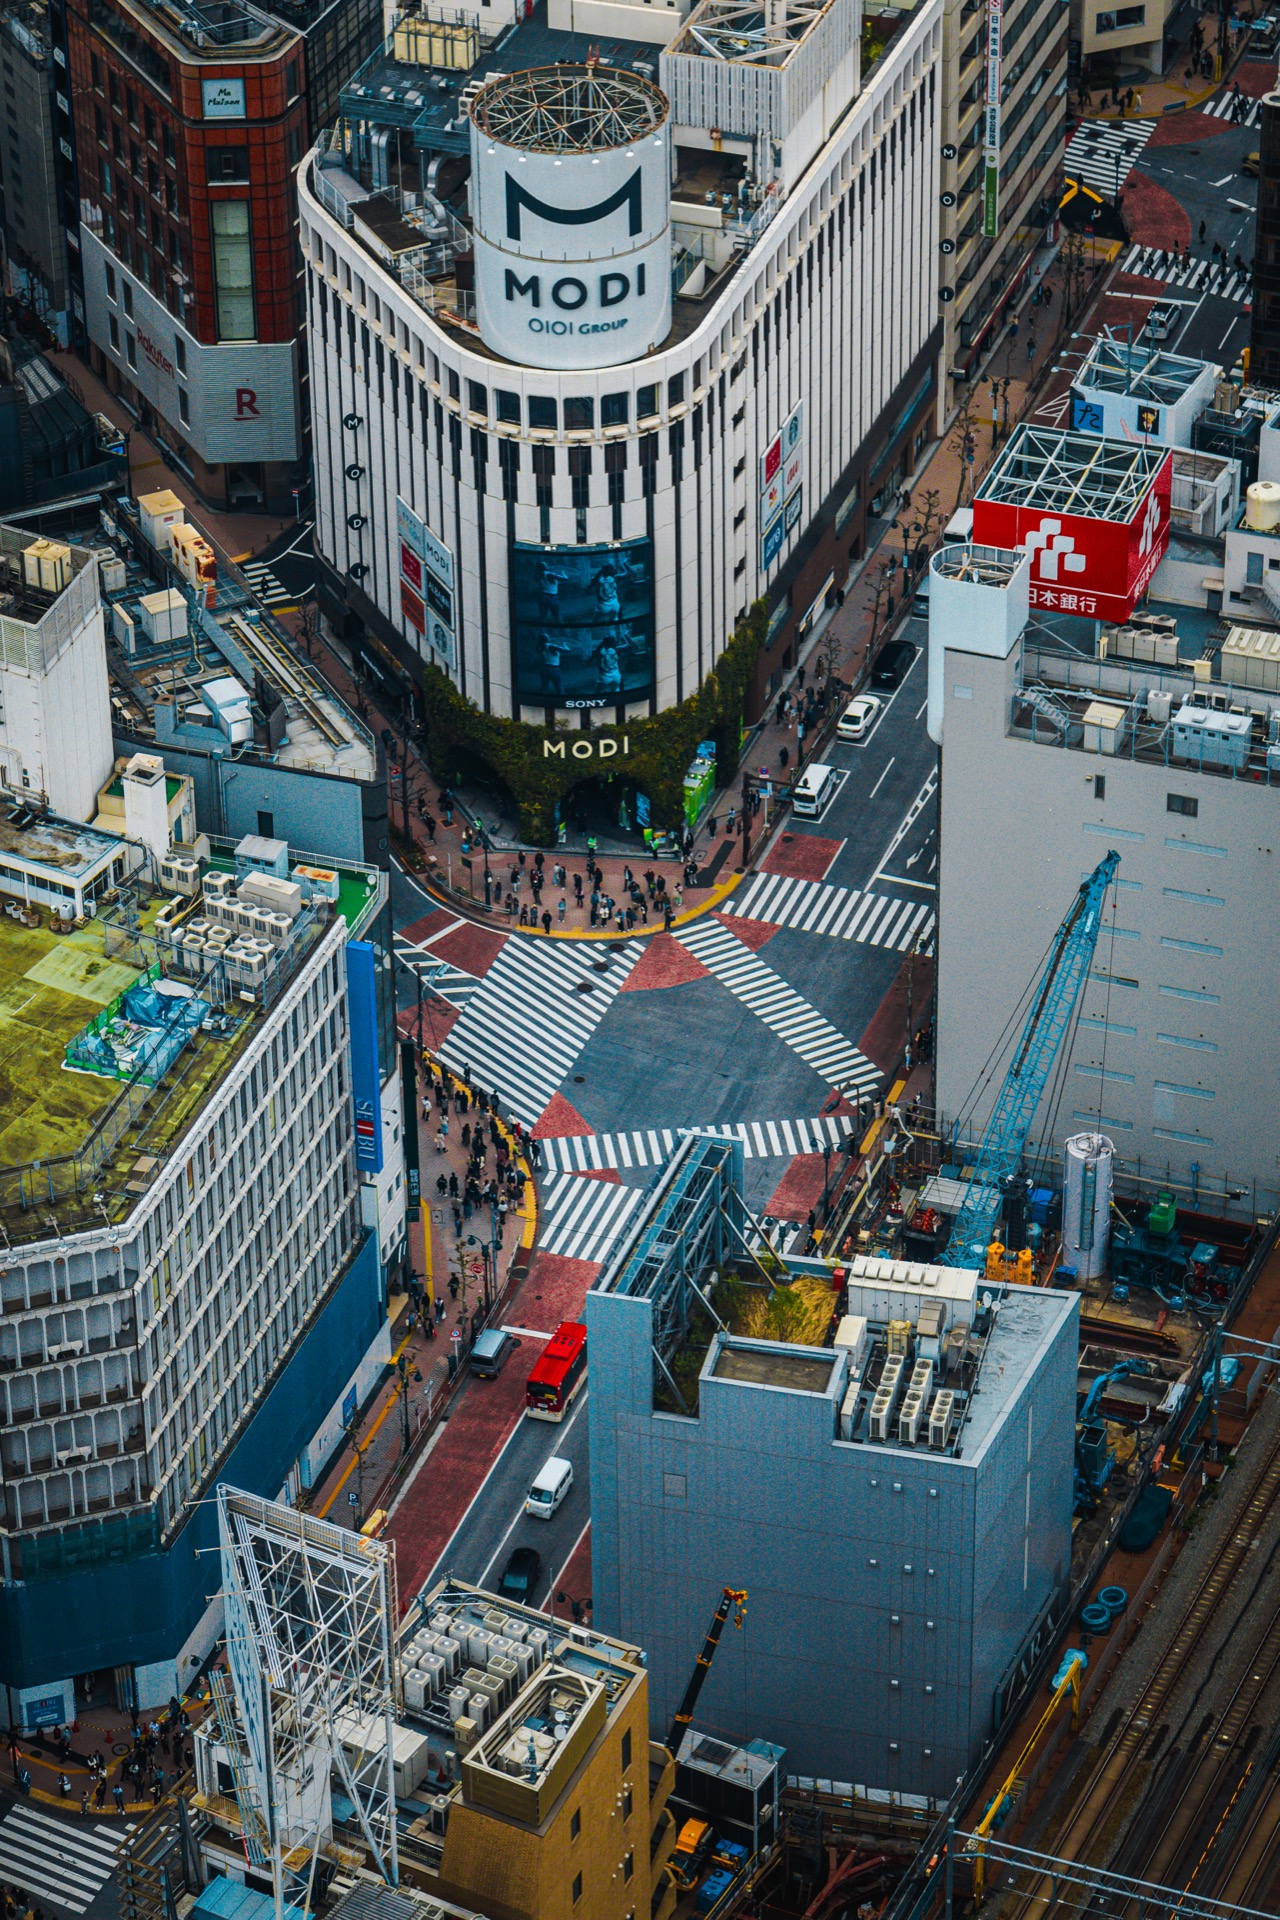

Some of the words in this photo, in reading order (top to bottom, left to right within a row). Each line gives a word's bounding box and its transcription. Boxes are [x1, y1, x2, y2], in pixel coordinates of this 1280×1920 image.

[218, 88, 232, 97] Ma
[505, 262, 646, 311] MODI
[137, 326, 175, 380] Rakuten
[235, 388, 261, 416] R
[426, 541, 450, 574] MODI
[565, 699, 607, 708] SONY
[543, 735, 629, 759] MODI
[355, 1097, 376, 1160] SEIBU
